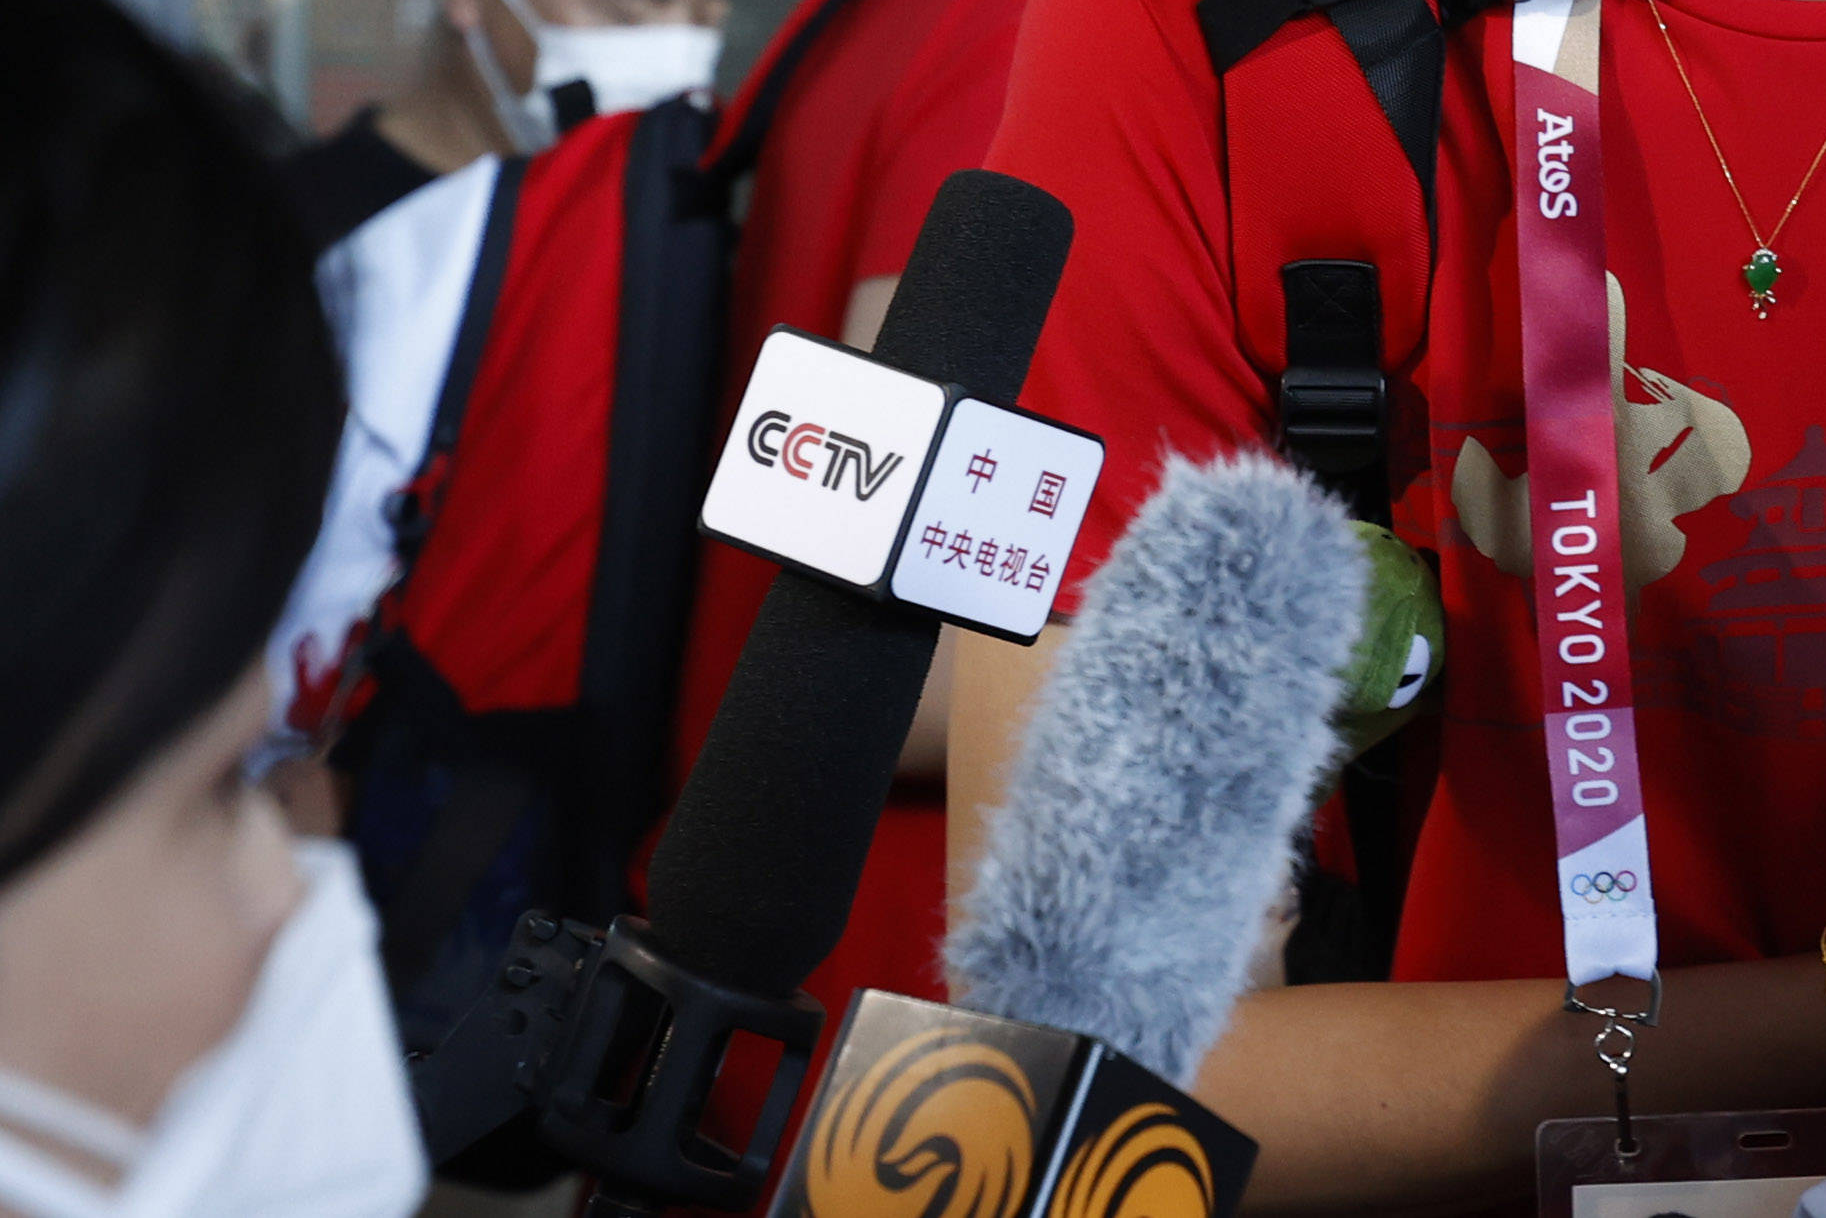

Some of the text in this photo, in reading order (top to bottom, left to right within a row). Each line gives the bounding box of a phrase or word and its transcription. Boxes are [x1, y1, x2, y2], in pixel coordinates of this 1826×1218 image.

[748, 410, 904, 501] CCTV
[920, 521, 1051, 594] 中央电视台
[1550, 490, 1618, 808] TOKYO 2020
